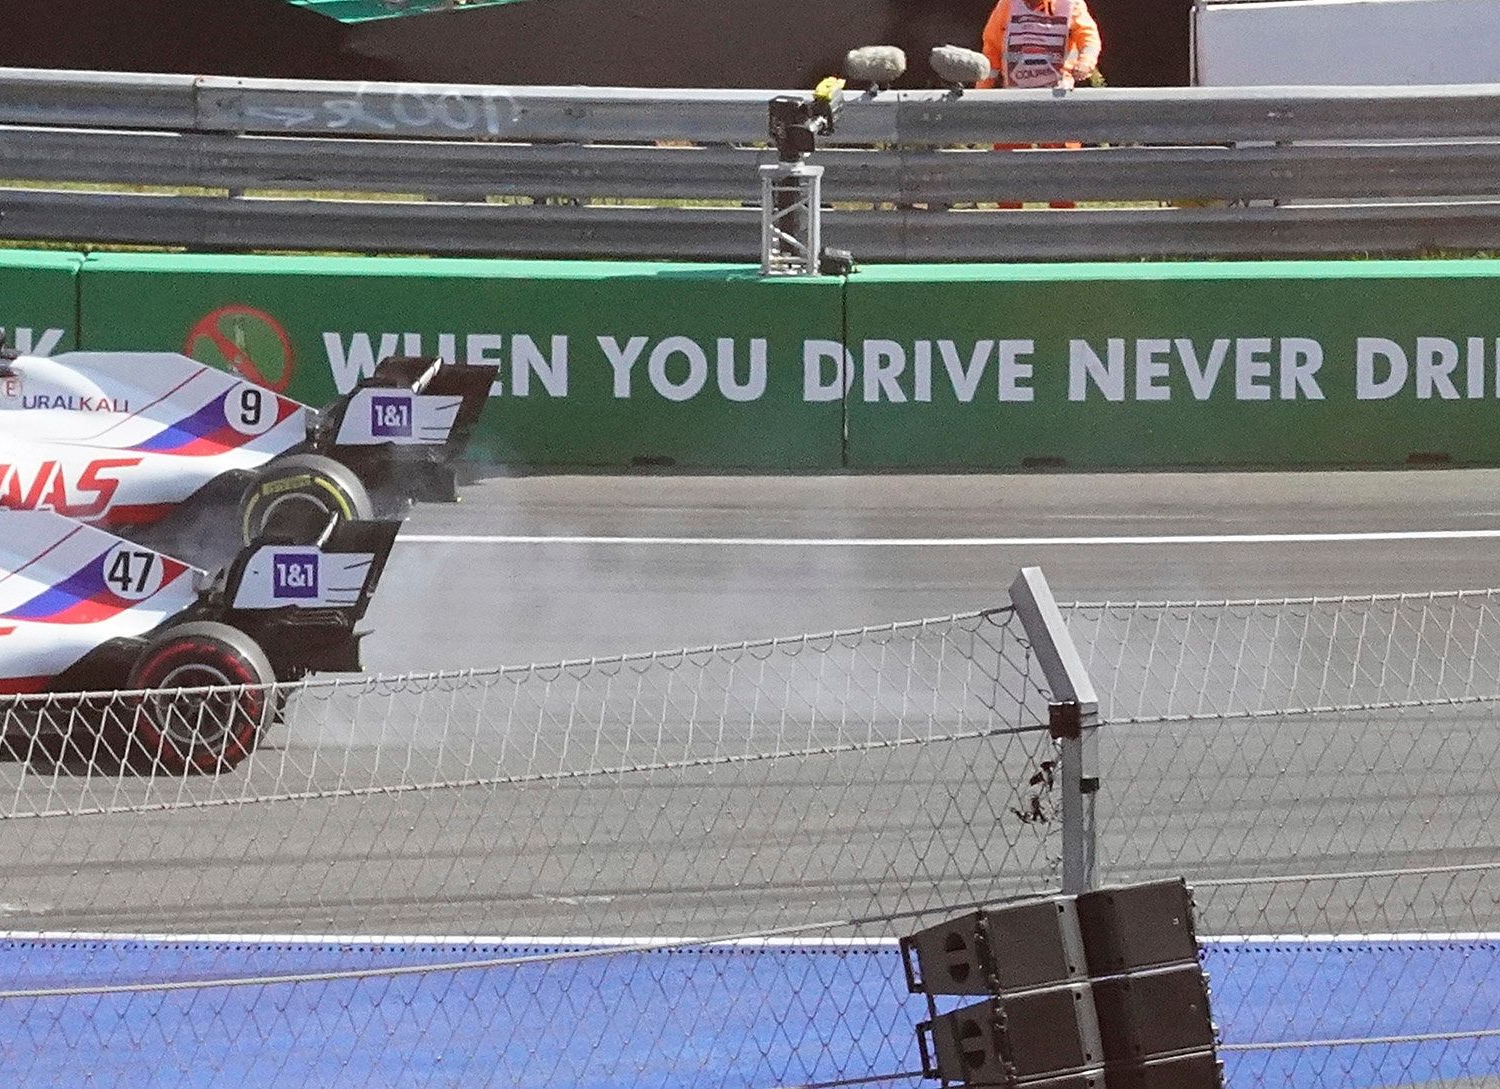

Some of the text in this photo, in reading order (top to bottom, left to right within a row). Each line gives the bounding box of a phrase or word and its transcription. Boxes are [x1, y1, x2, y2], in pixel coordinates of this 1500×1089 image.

[596, 335, 768, 402] YOU
[803, 339, 1035, 402] DRIVE
[1068, 338, 1326, 402] NEVER
[1355, 336, 1500, 400] DRI
[22, 394, 129, 414] URALKALI
[240, 389, 262, 426] 9
[374, 404, 408, 428] 1&1
[107, 550, 155, 593] 47
[276, 563, 314, 588] 1&1
